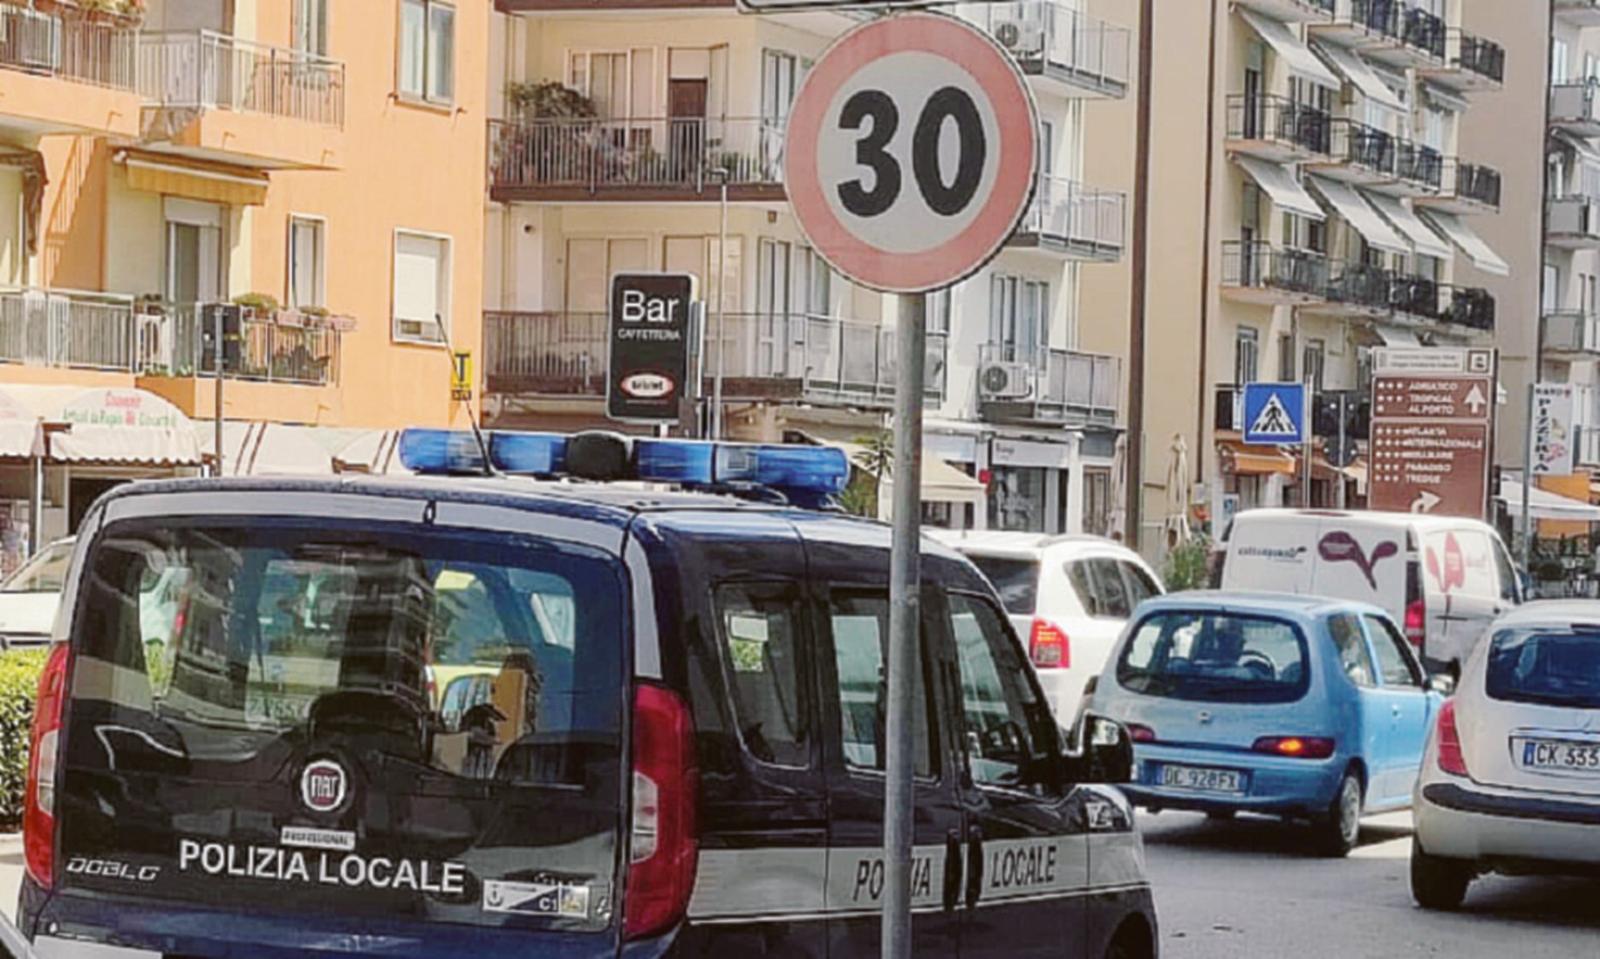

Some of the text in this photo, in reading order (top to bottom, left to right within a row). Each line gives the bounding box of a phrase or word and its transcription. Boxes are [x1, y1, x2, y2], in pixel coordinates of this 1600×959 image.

[837, 86, 986, 217] 30
[622, 290, 679, 321] Bar
[1537, 743, 1559, 764] CK
[311, 775, 338, 798] FIAT
[180, 839, 466, 893] POLIZIA LOCALE
[853, 846, 1057, 901] POIA LOCALE
